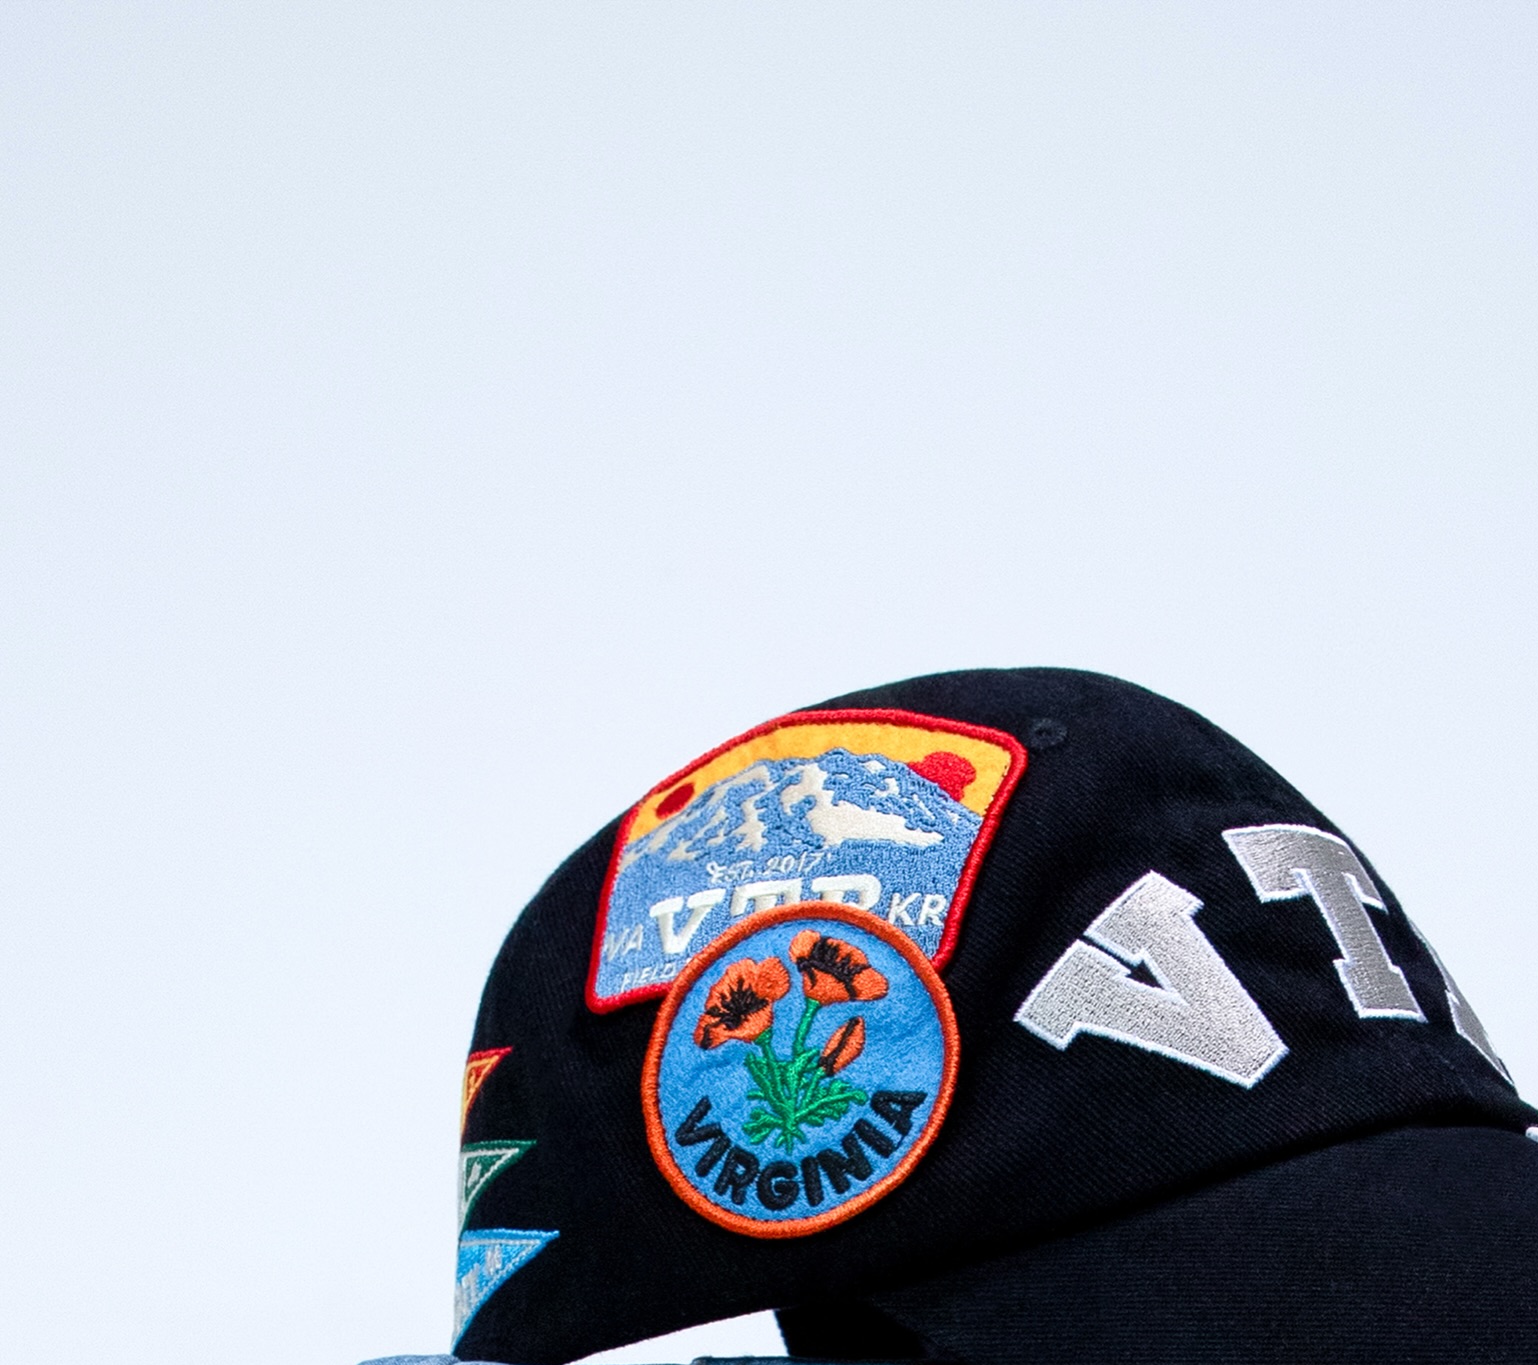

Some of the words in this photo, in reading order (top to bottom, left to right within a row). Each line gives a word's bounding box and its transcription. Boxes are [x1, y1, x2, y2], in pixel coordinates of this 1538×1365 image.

[888, 891, 948, 927] KR
[1014, 821, 1514, 1088] VT
[674, 1089, 928, 1211] VIRGINIA
